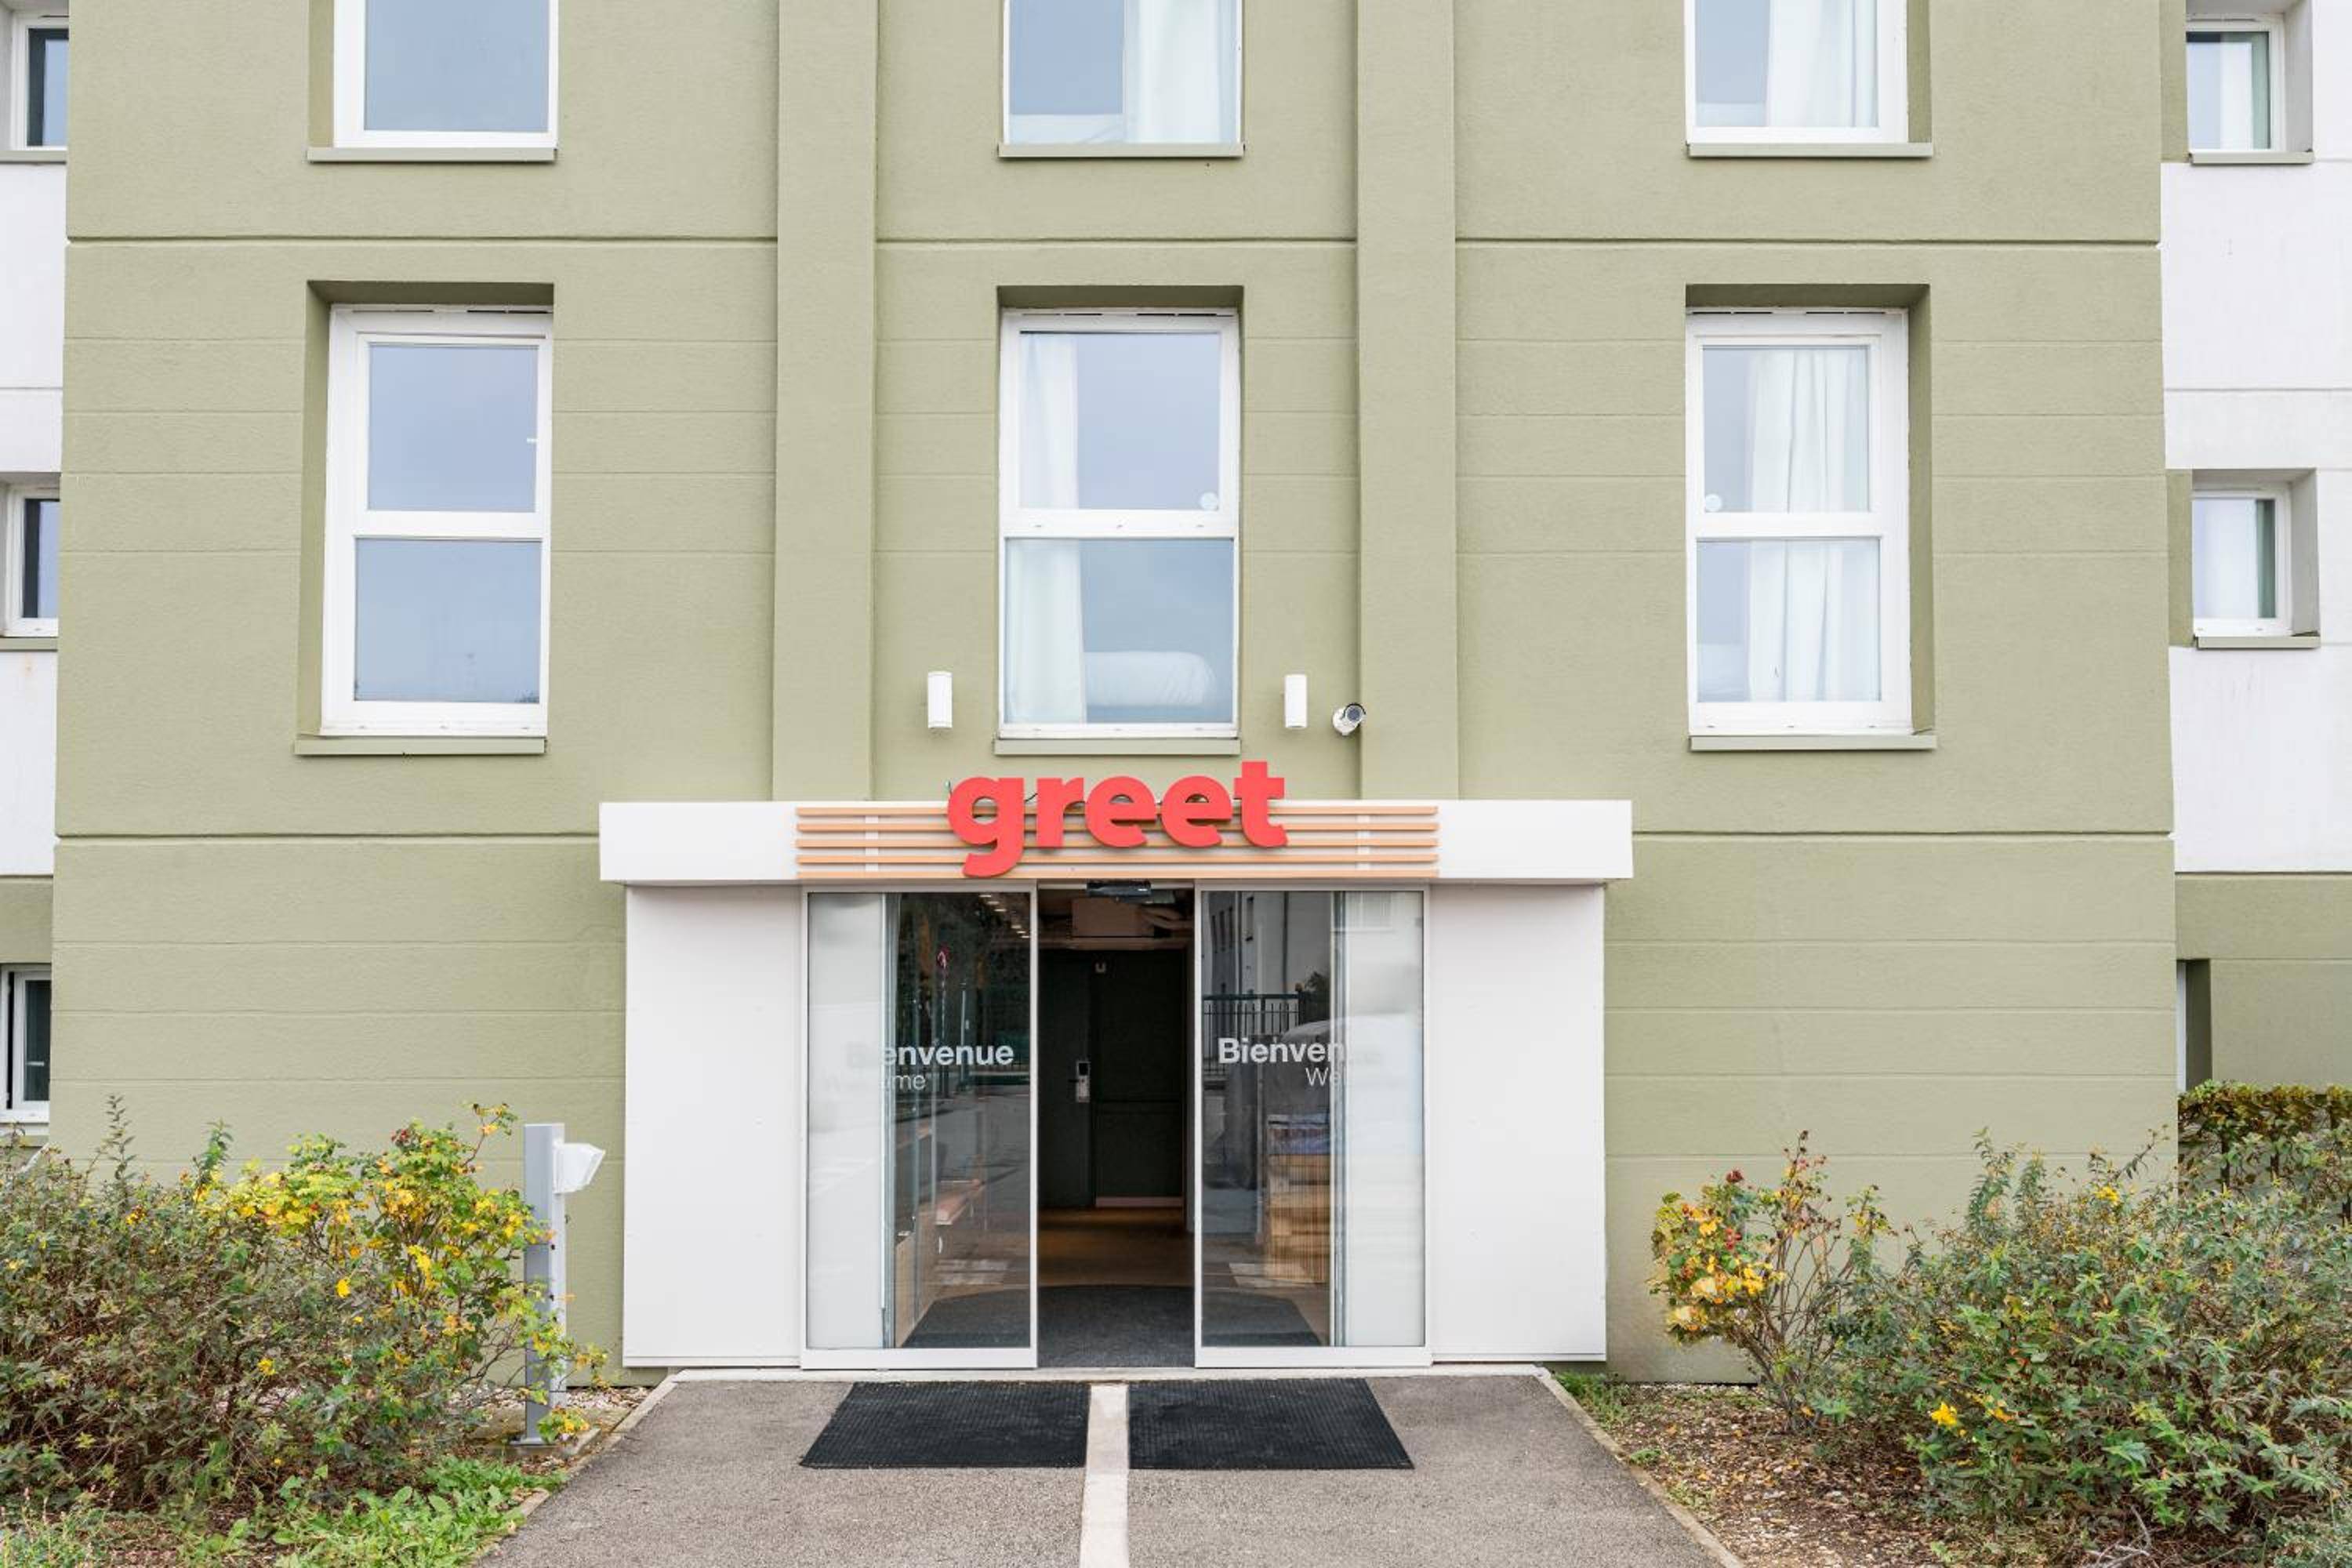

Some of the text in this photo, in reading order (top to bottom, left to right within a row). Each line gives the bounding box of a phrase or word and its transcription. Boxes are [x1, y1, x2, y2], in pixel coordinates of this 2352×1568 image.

[947, 760, 1288, 877] greet
[847, 1041, 1014, 1065] envenue
[1218, 1036, 1381, 1064] Bienven
